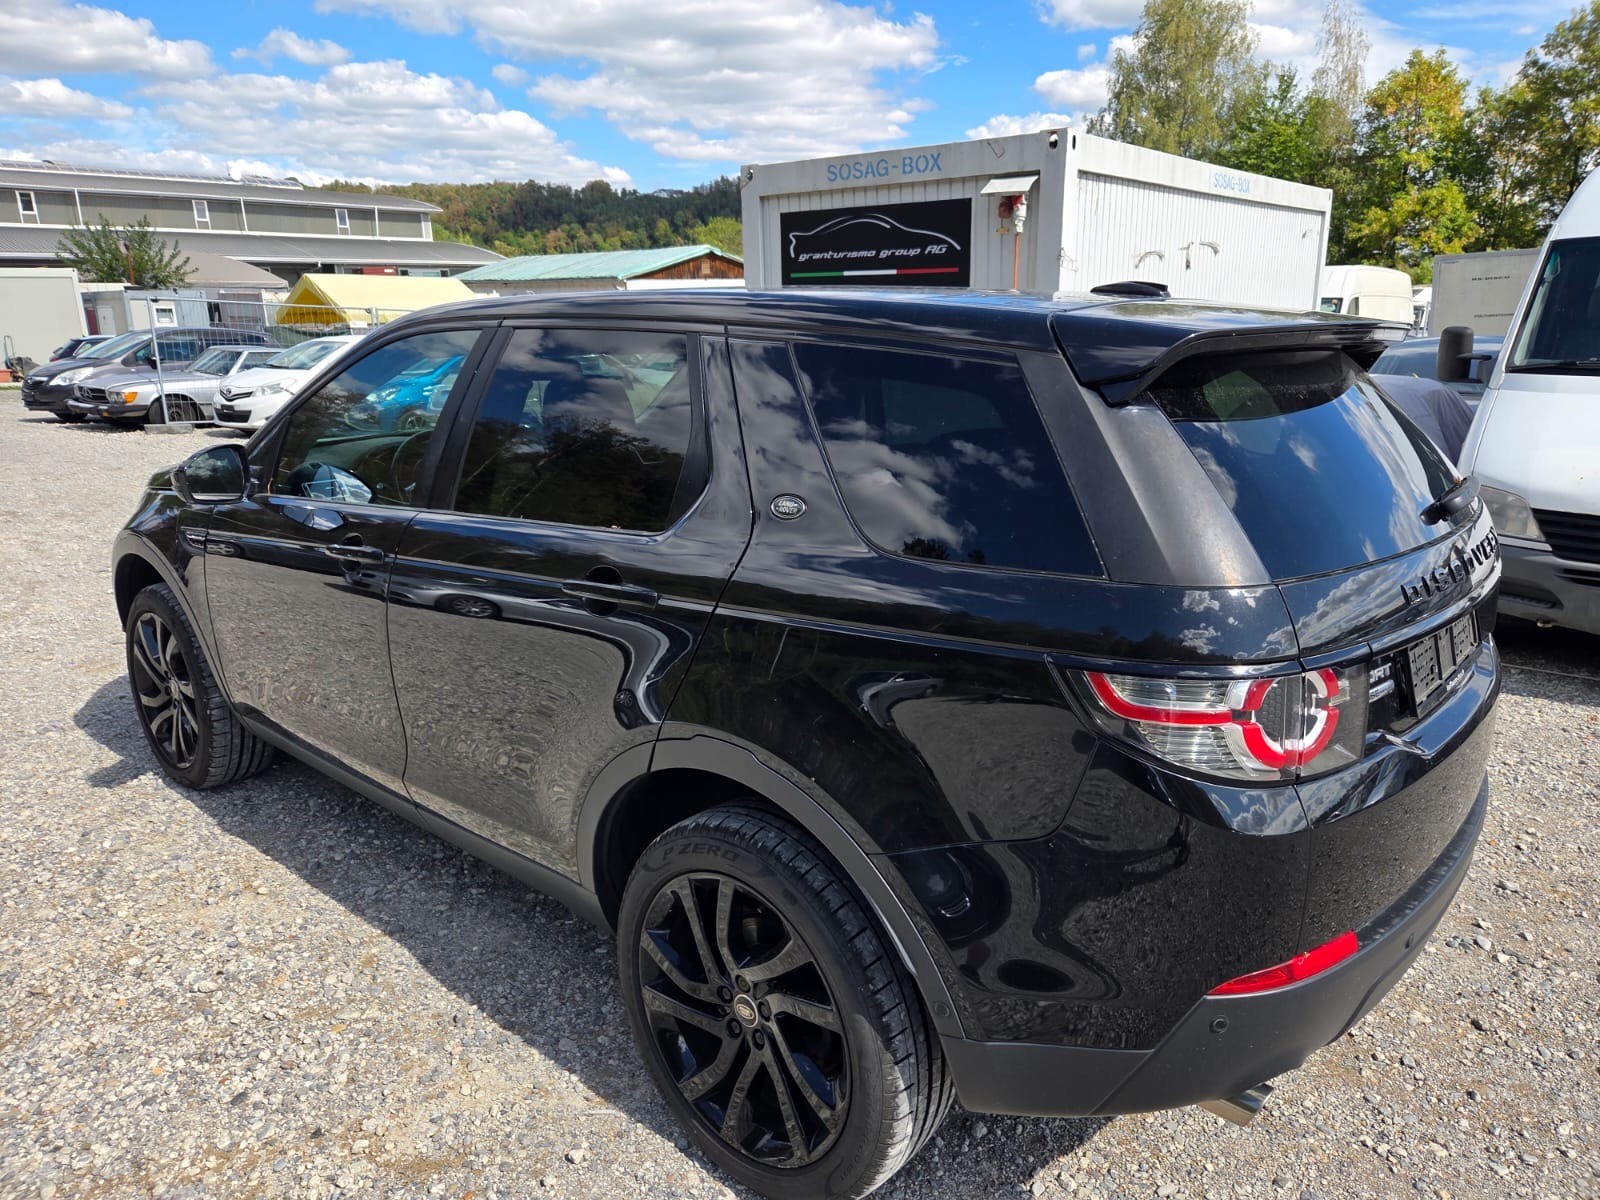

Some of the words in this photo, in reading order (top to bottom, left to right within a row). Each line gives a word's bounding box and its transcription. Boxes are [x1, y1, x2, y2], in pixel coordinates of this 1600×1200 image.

[826, 152, 942, 182] SOSAG-BOX
[798, 249, 876, 262] granturismo
[879, 248, 920, 259] group
[1400, 527, 1498, 607] DISCOVER
[678, 842, 740, 862] ZERO
